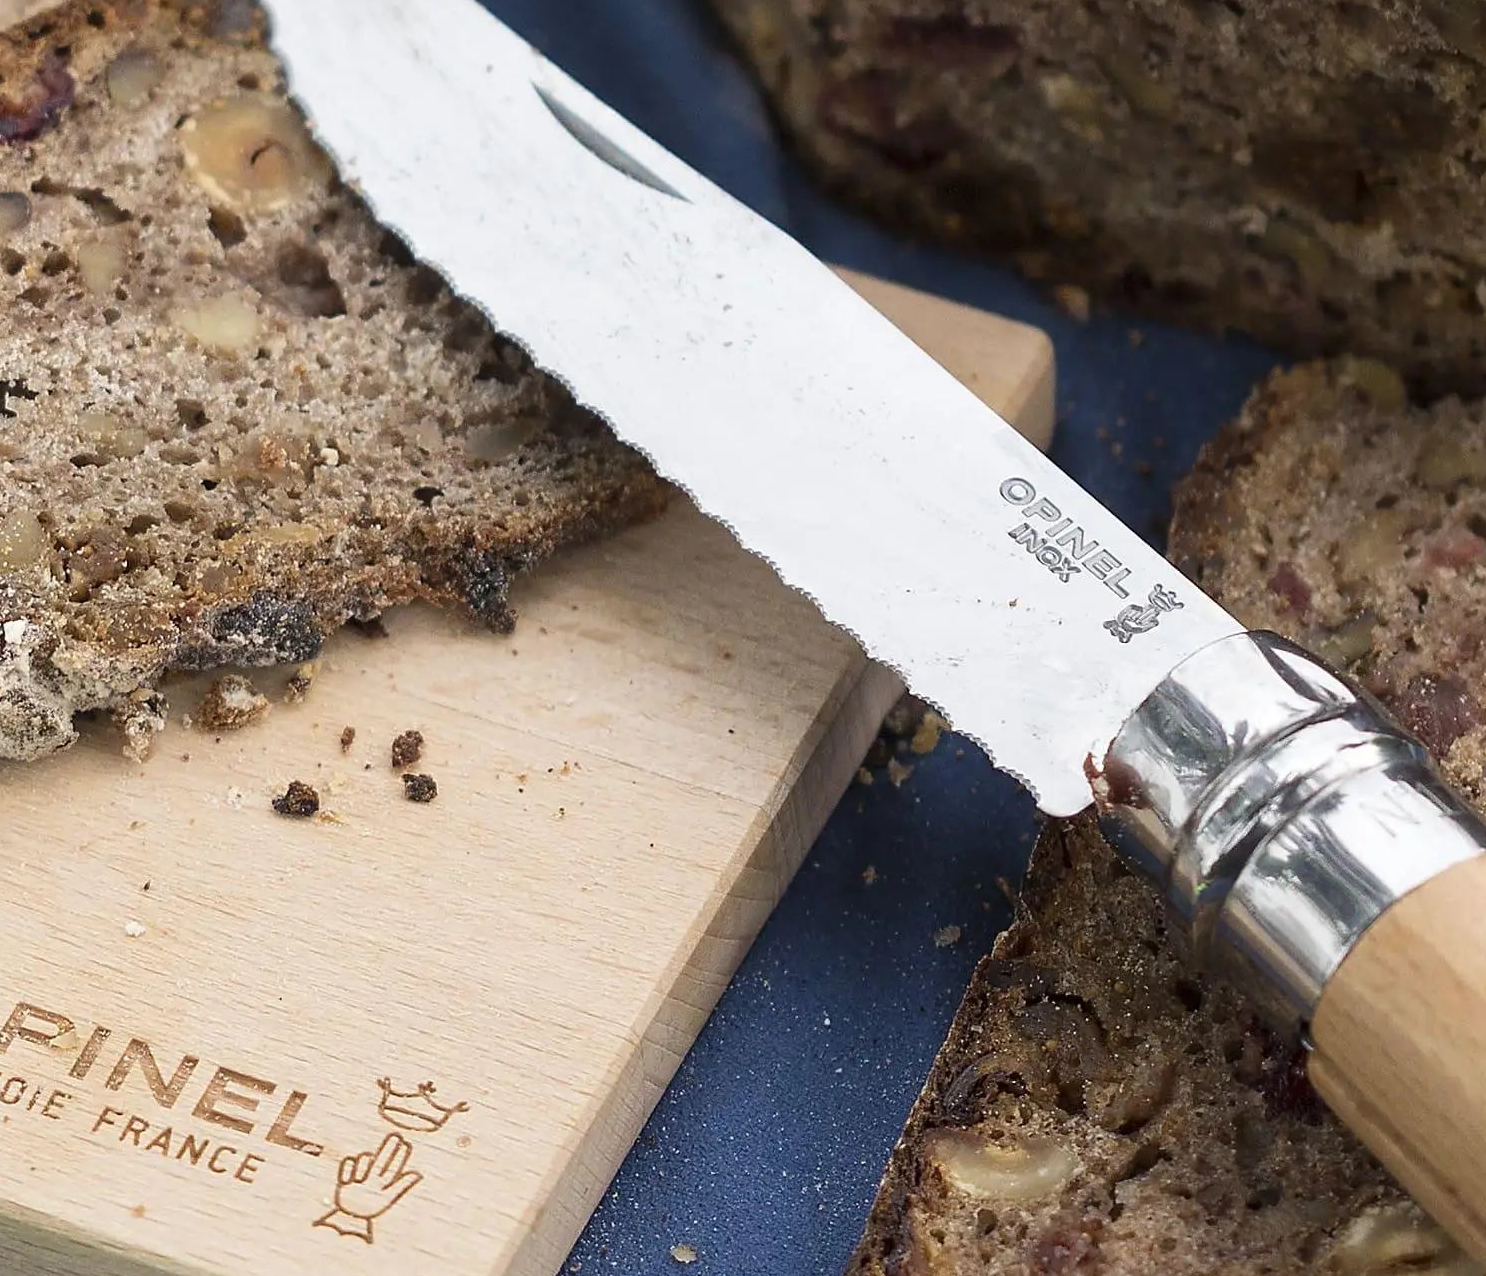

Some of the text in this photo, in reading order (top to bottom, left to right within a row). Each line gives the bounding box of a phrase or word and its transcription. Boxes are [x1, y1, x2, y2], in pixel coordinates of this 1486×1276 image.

[999, 477, 1131, 599] OPINEL
[1008, 522, 1081, 583] INOX
[91, 1107, 266, 1183] FRANCE
